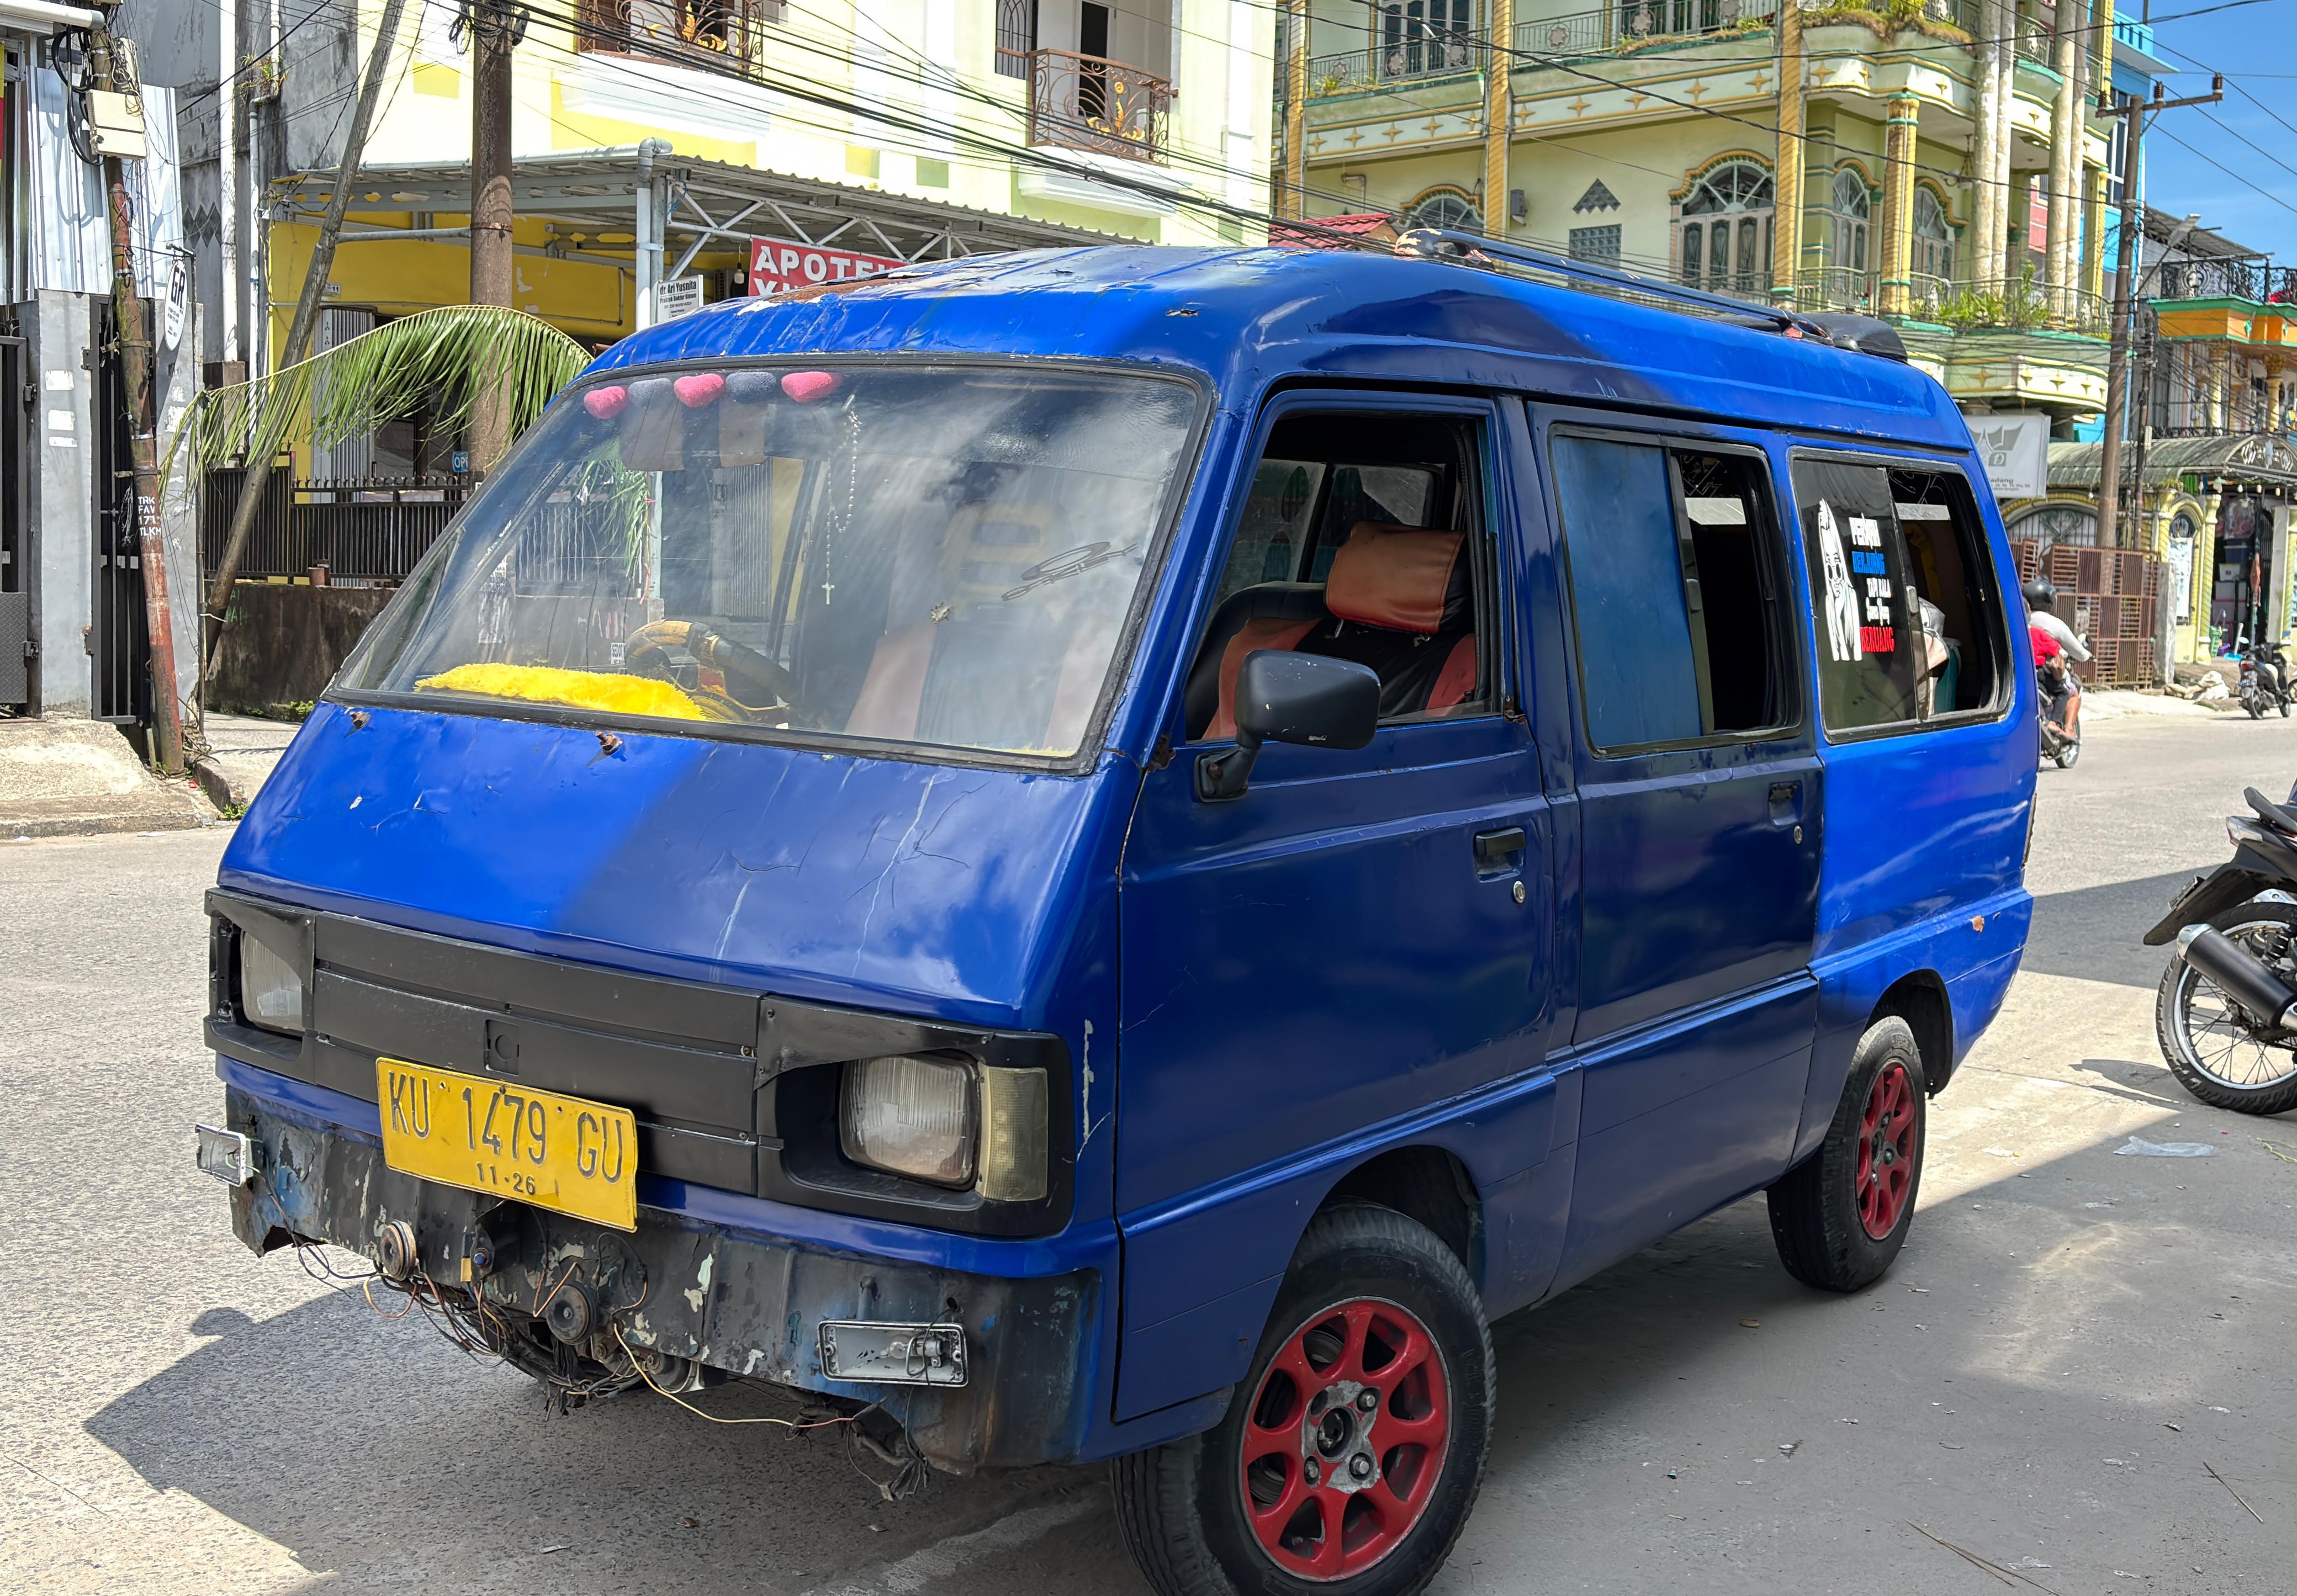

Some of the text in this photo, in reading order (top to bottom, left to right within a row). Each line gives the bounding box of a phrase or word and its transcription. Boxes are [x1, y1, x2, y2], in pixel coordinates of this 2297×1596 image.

[754, 246, 893, 282] APOTE
[676, 280, 696, 292] Yusnita
[137, 496, 155, 505] TRK
[138, 505, 155, 515] FAV
[139, 526, 161, 536] TLKM
[1860, 626, 1894, 652] BERUANG
[388, 1070, 622, 1184] KU 1479 GU
